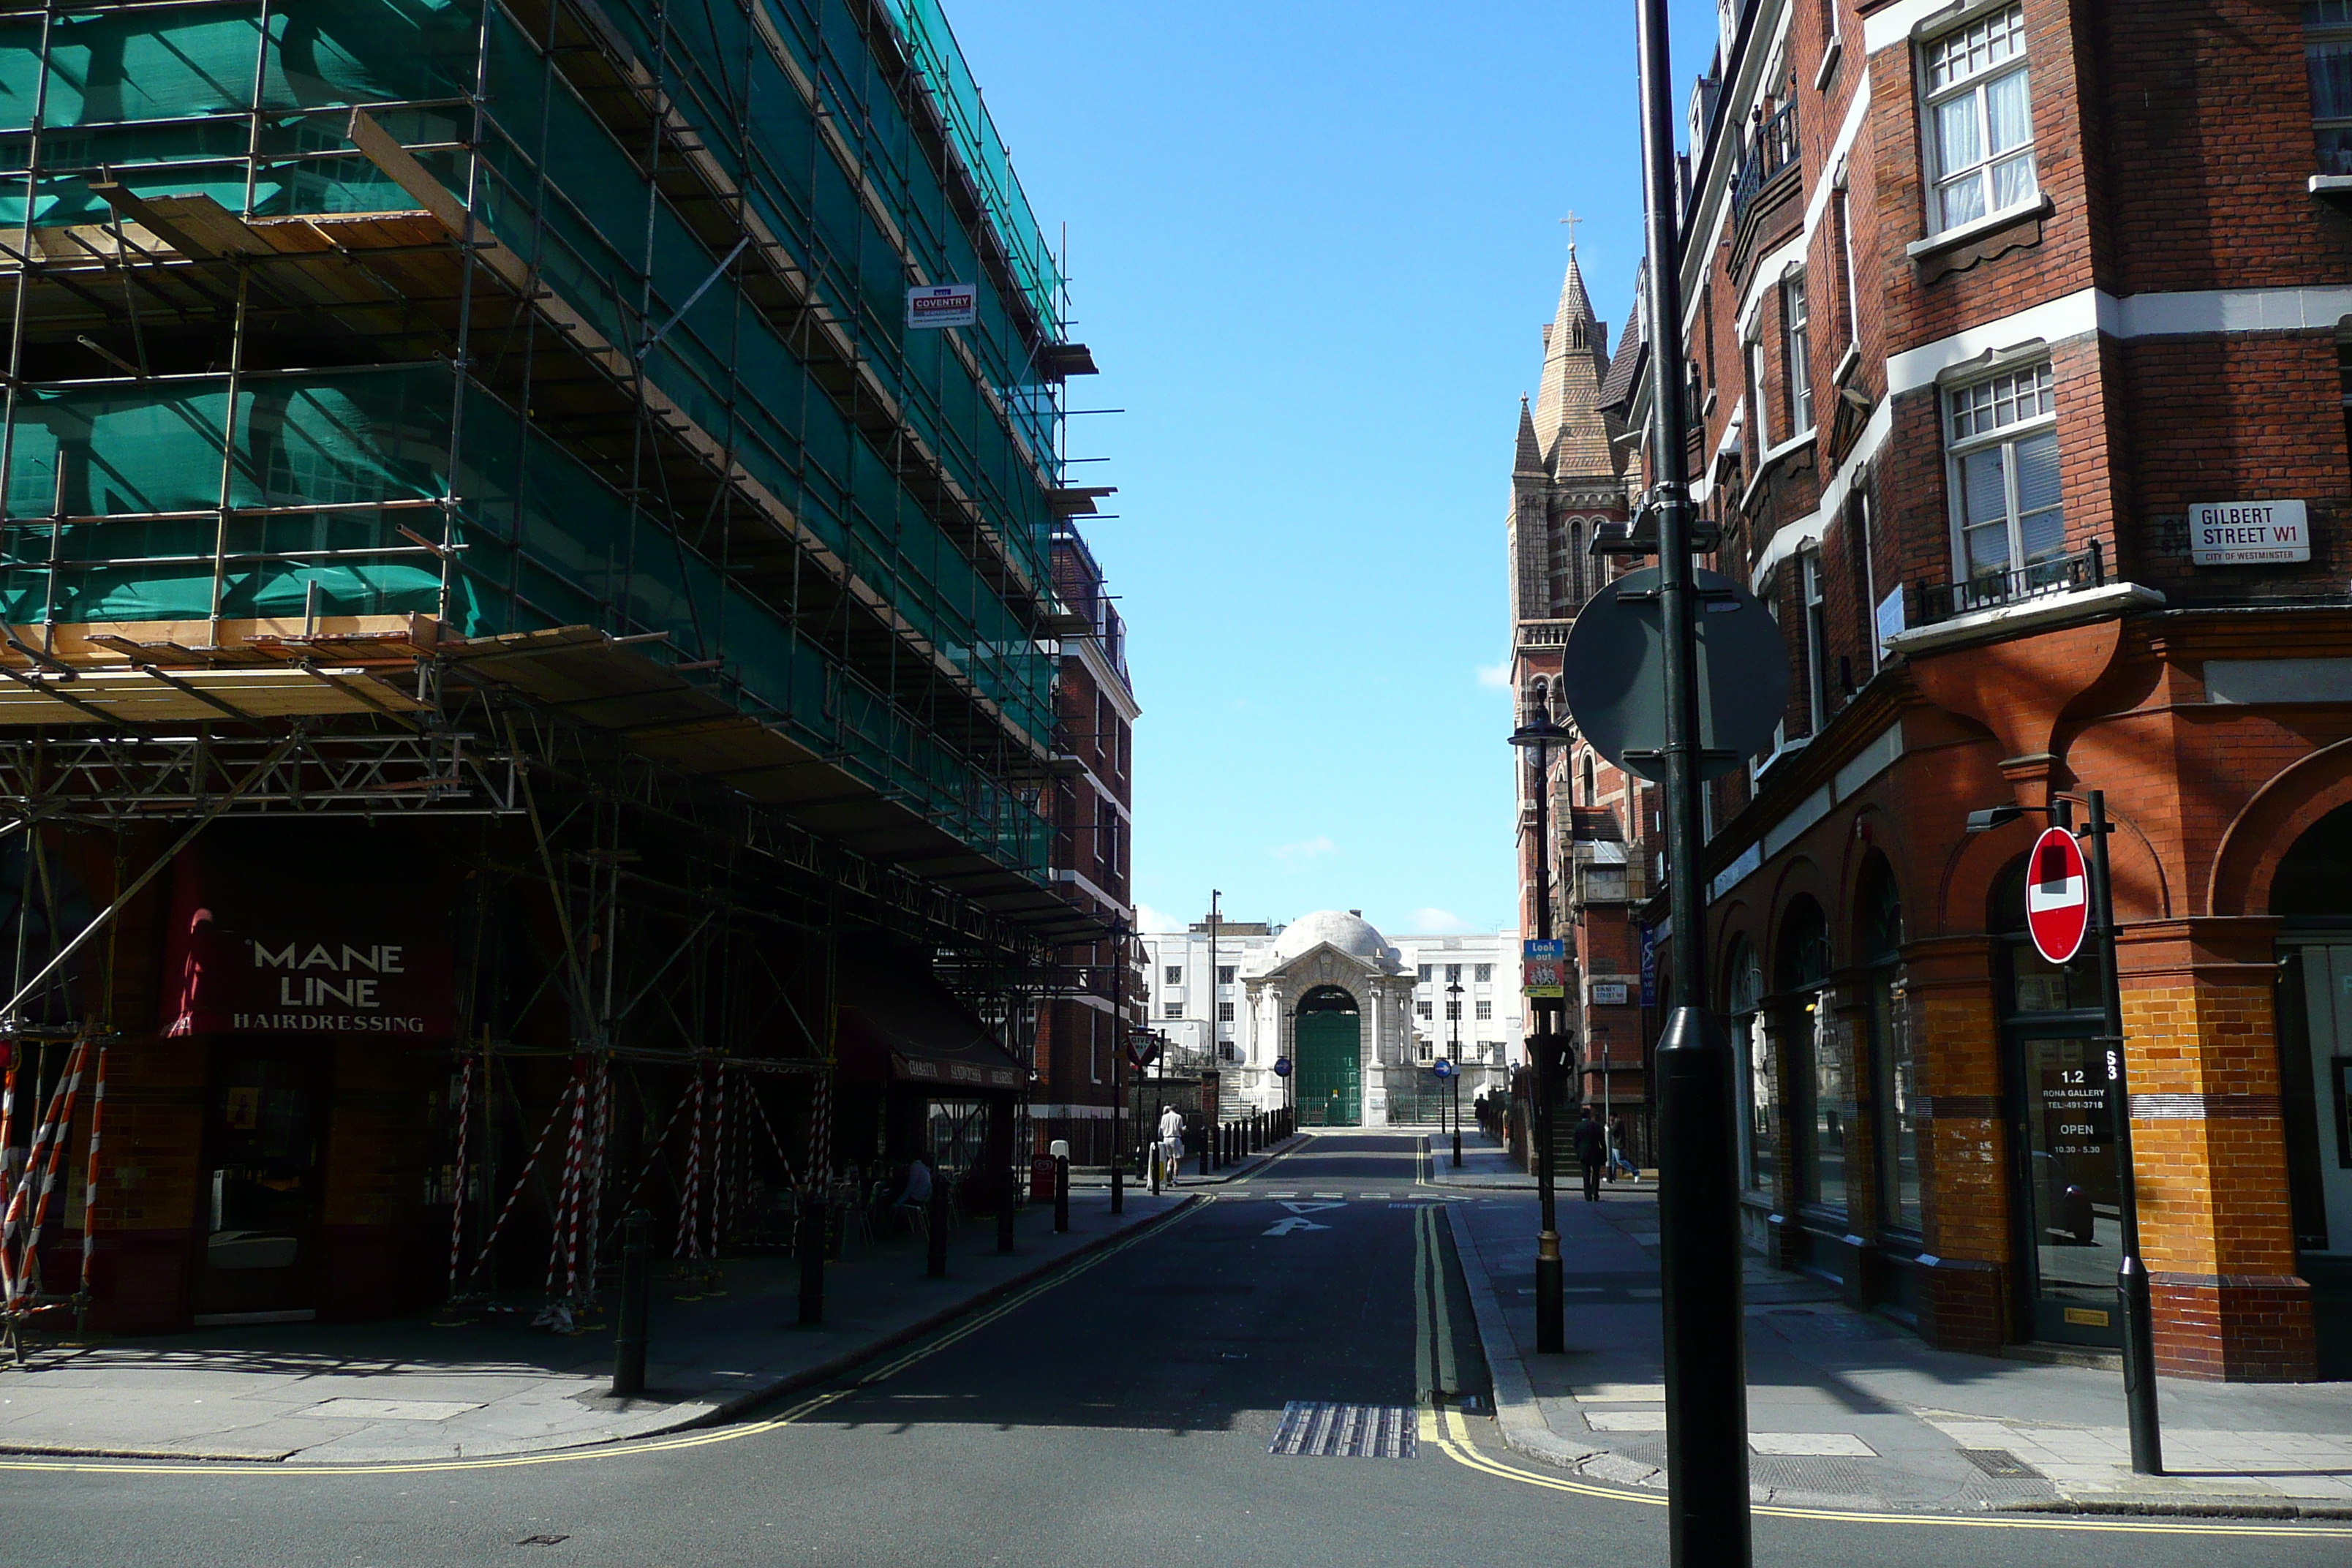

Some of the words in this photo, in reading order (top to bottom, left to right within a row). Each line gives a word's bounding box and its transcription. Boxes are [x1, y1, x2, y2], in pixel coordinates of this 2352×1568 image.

[916, 297, 969, 307] COVENTRY
[2201, 508, 2273, 525] GILBERT
[2204, 527, 2266, 544] STREET
[2273, 526, 2297, 542] W1
[2206, 553, 2223, 561] CITY
[2225, 552, 2236, 560] OF
[2236, 551, 2293, 560] WESTMINSTER
[1532, 941, 1555, 951] Look
[255, 941, 405, 973] MANE
[282, 976, 380, 1007] LINE
[233, 1013, 424, 1033] HAIRDRESSING
[2059, 1124, 2094, 1134] OPEN
